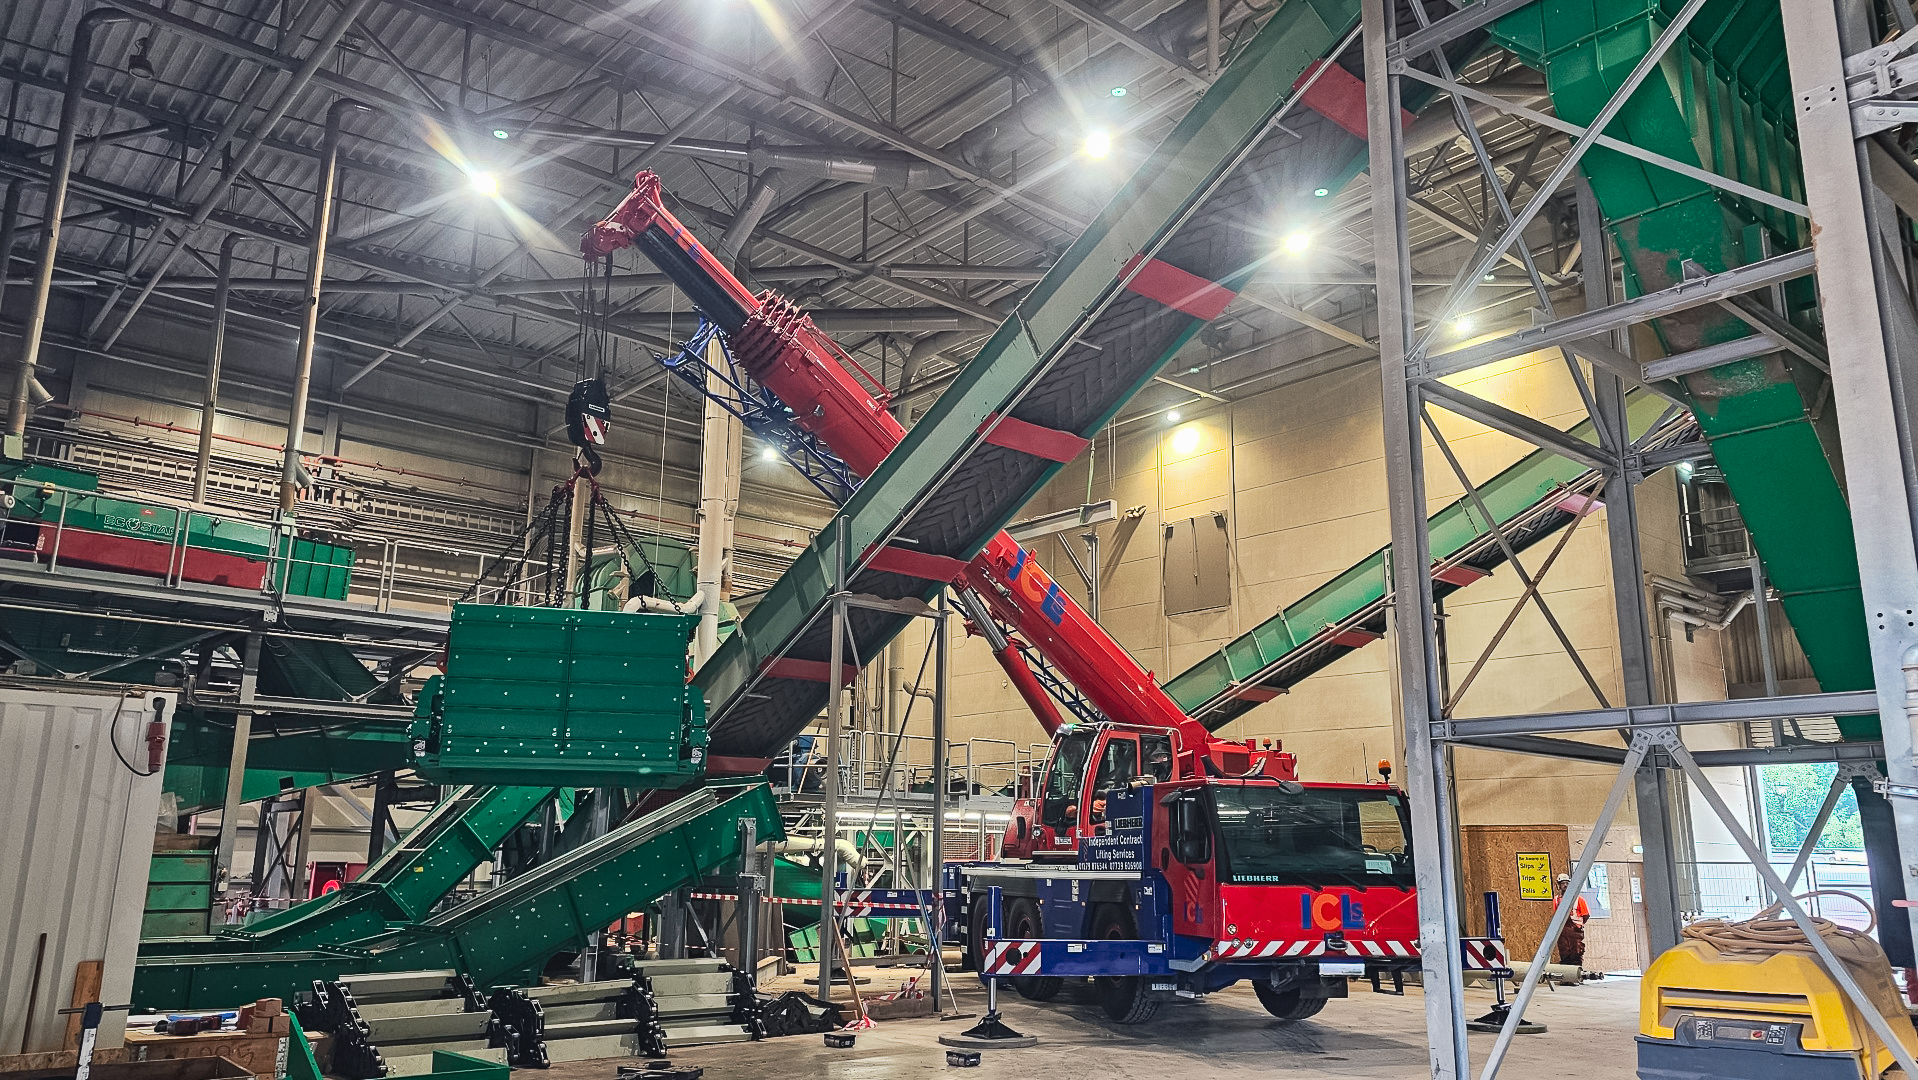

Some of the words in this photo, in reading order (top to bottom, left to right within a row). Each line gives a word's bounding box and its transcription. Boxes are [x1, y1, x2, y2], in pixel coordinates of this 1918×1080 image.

[1089, 836, 1119, 847] Independent
[1120, 834, 1143, 845] Contract
[1095, 849, 1112, 860] Lifting
[1113, 849, 1135, 859] Services
